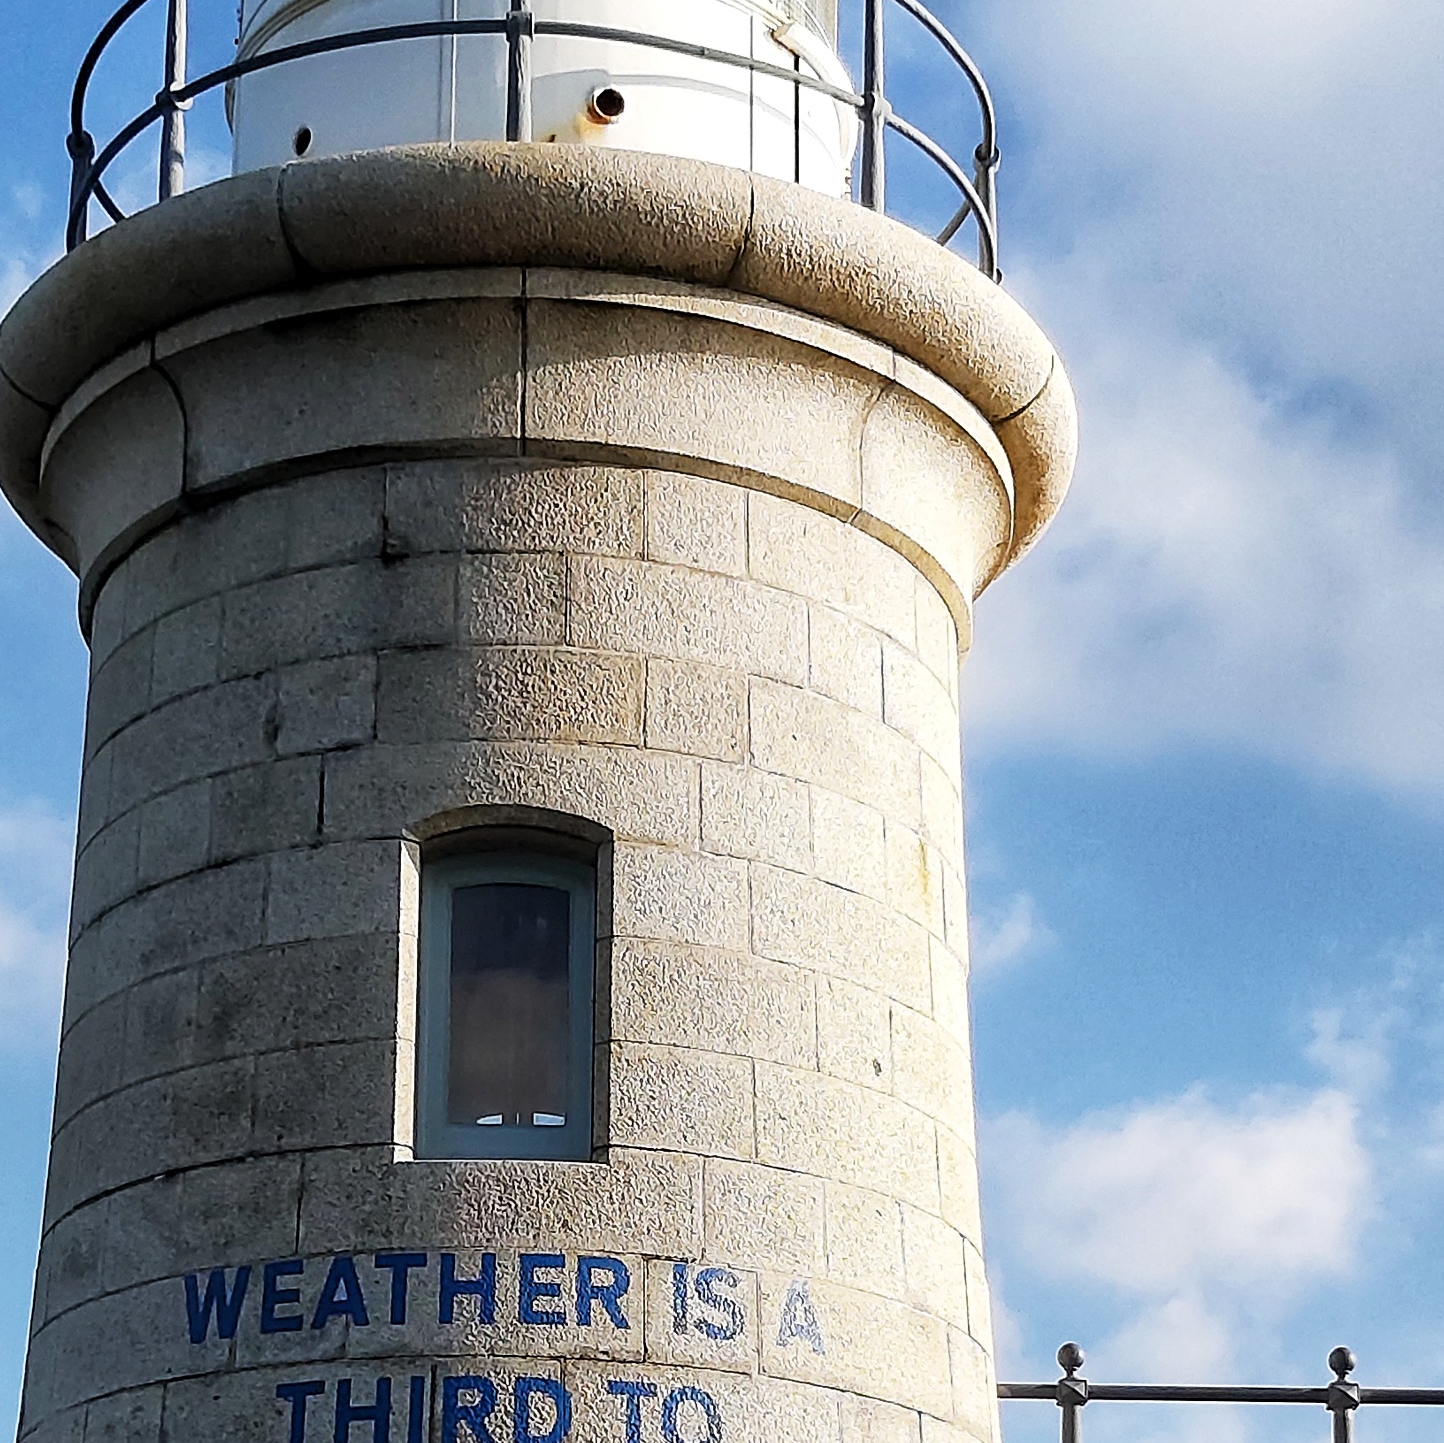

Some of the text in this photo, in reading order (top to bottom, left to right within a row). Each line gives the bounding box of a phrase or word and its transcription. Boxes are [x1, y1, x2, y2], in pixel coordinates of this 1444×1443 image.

[184, 1252, 827, 1357] WEATHER IS A
